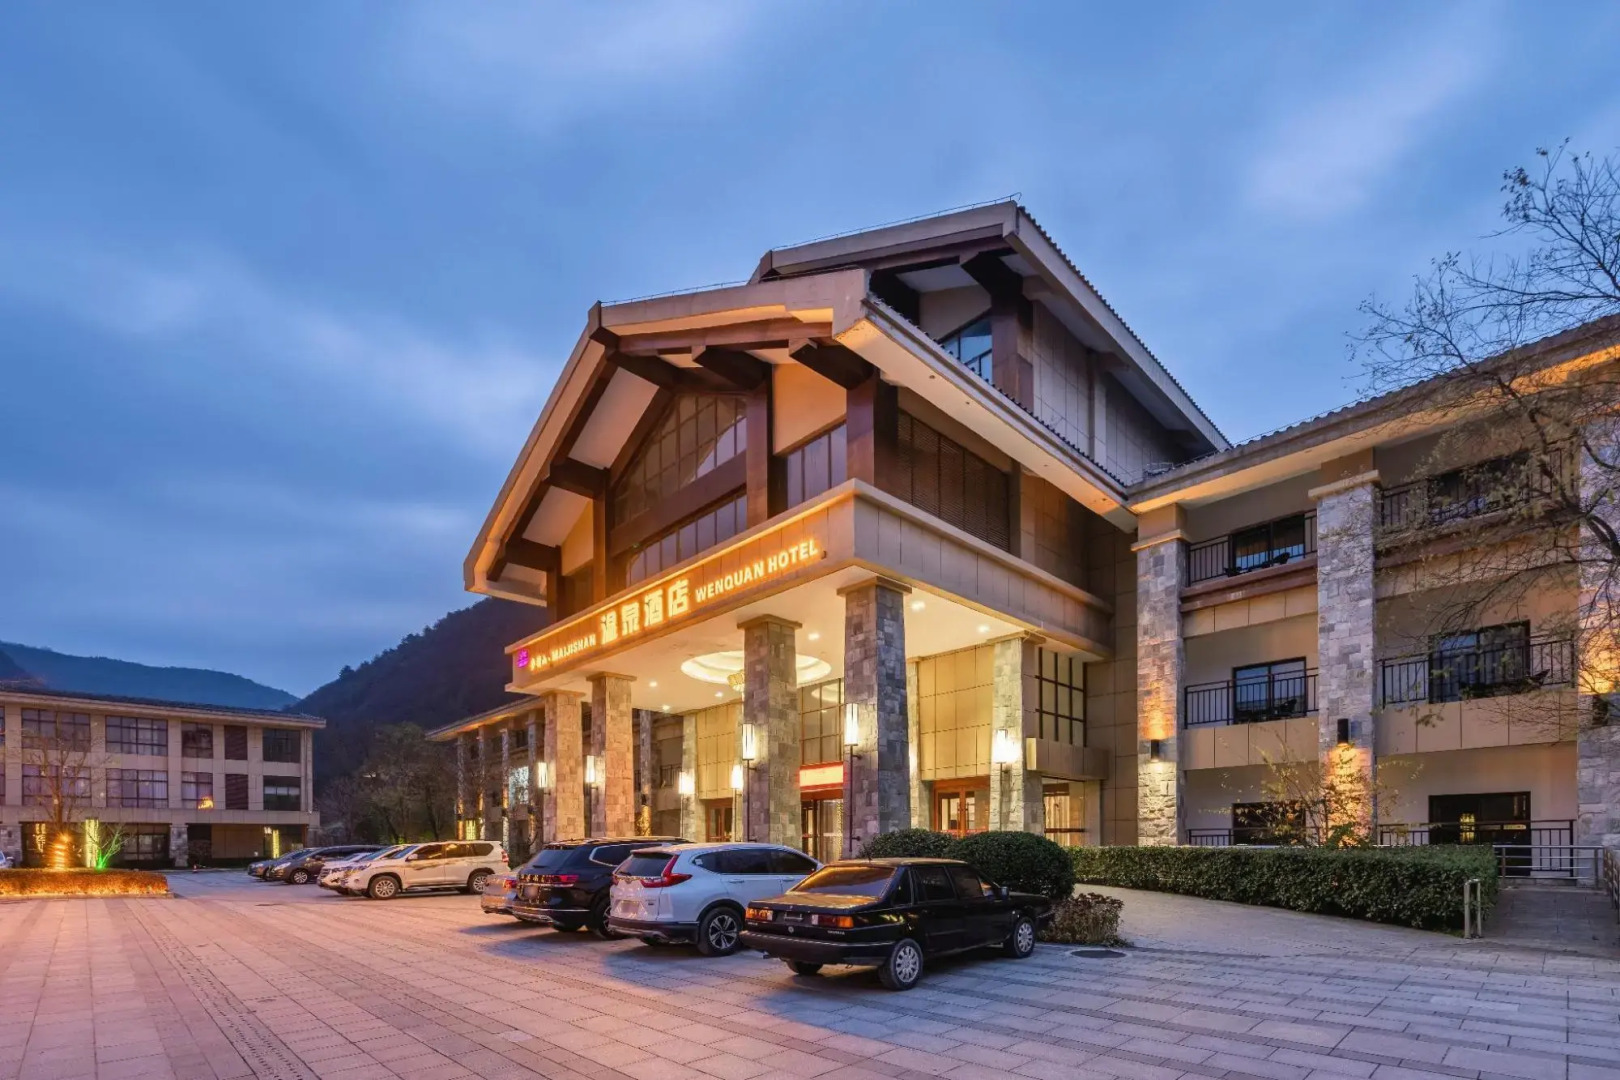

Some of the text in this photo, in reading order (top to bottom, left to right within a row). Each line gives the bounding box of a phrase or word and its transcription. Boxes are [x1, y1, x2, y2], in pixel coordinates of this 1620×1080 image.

[695, 539, 819, 603] WENQUAN HOTEL
[600, 578, 689, 645] 温泉酒店
